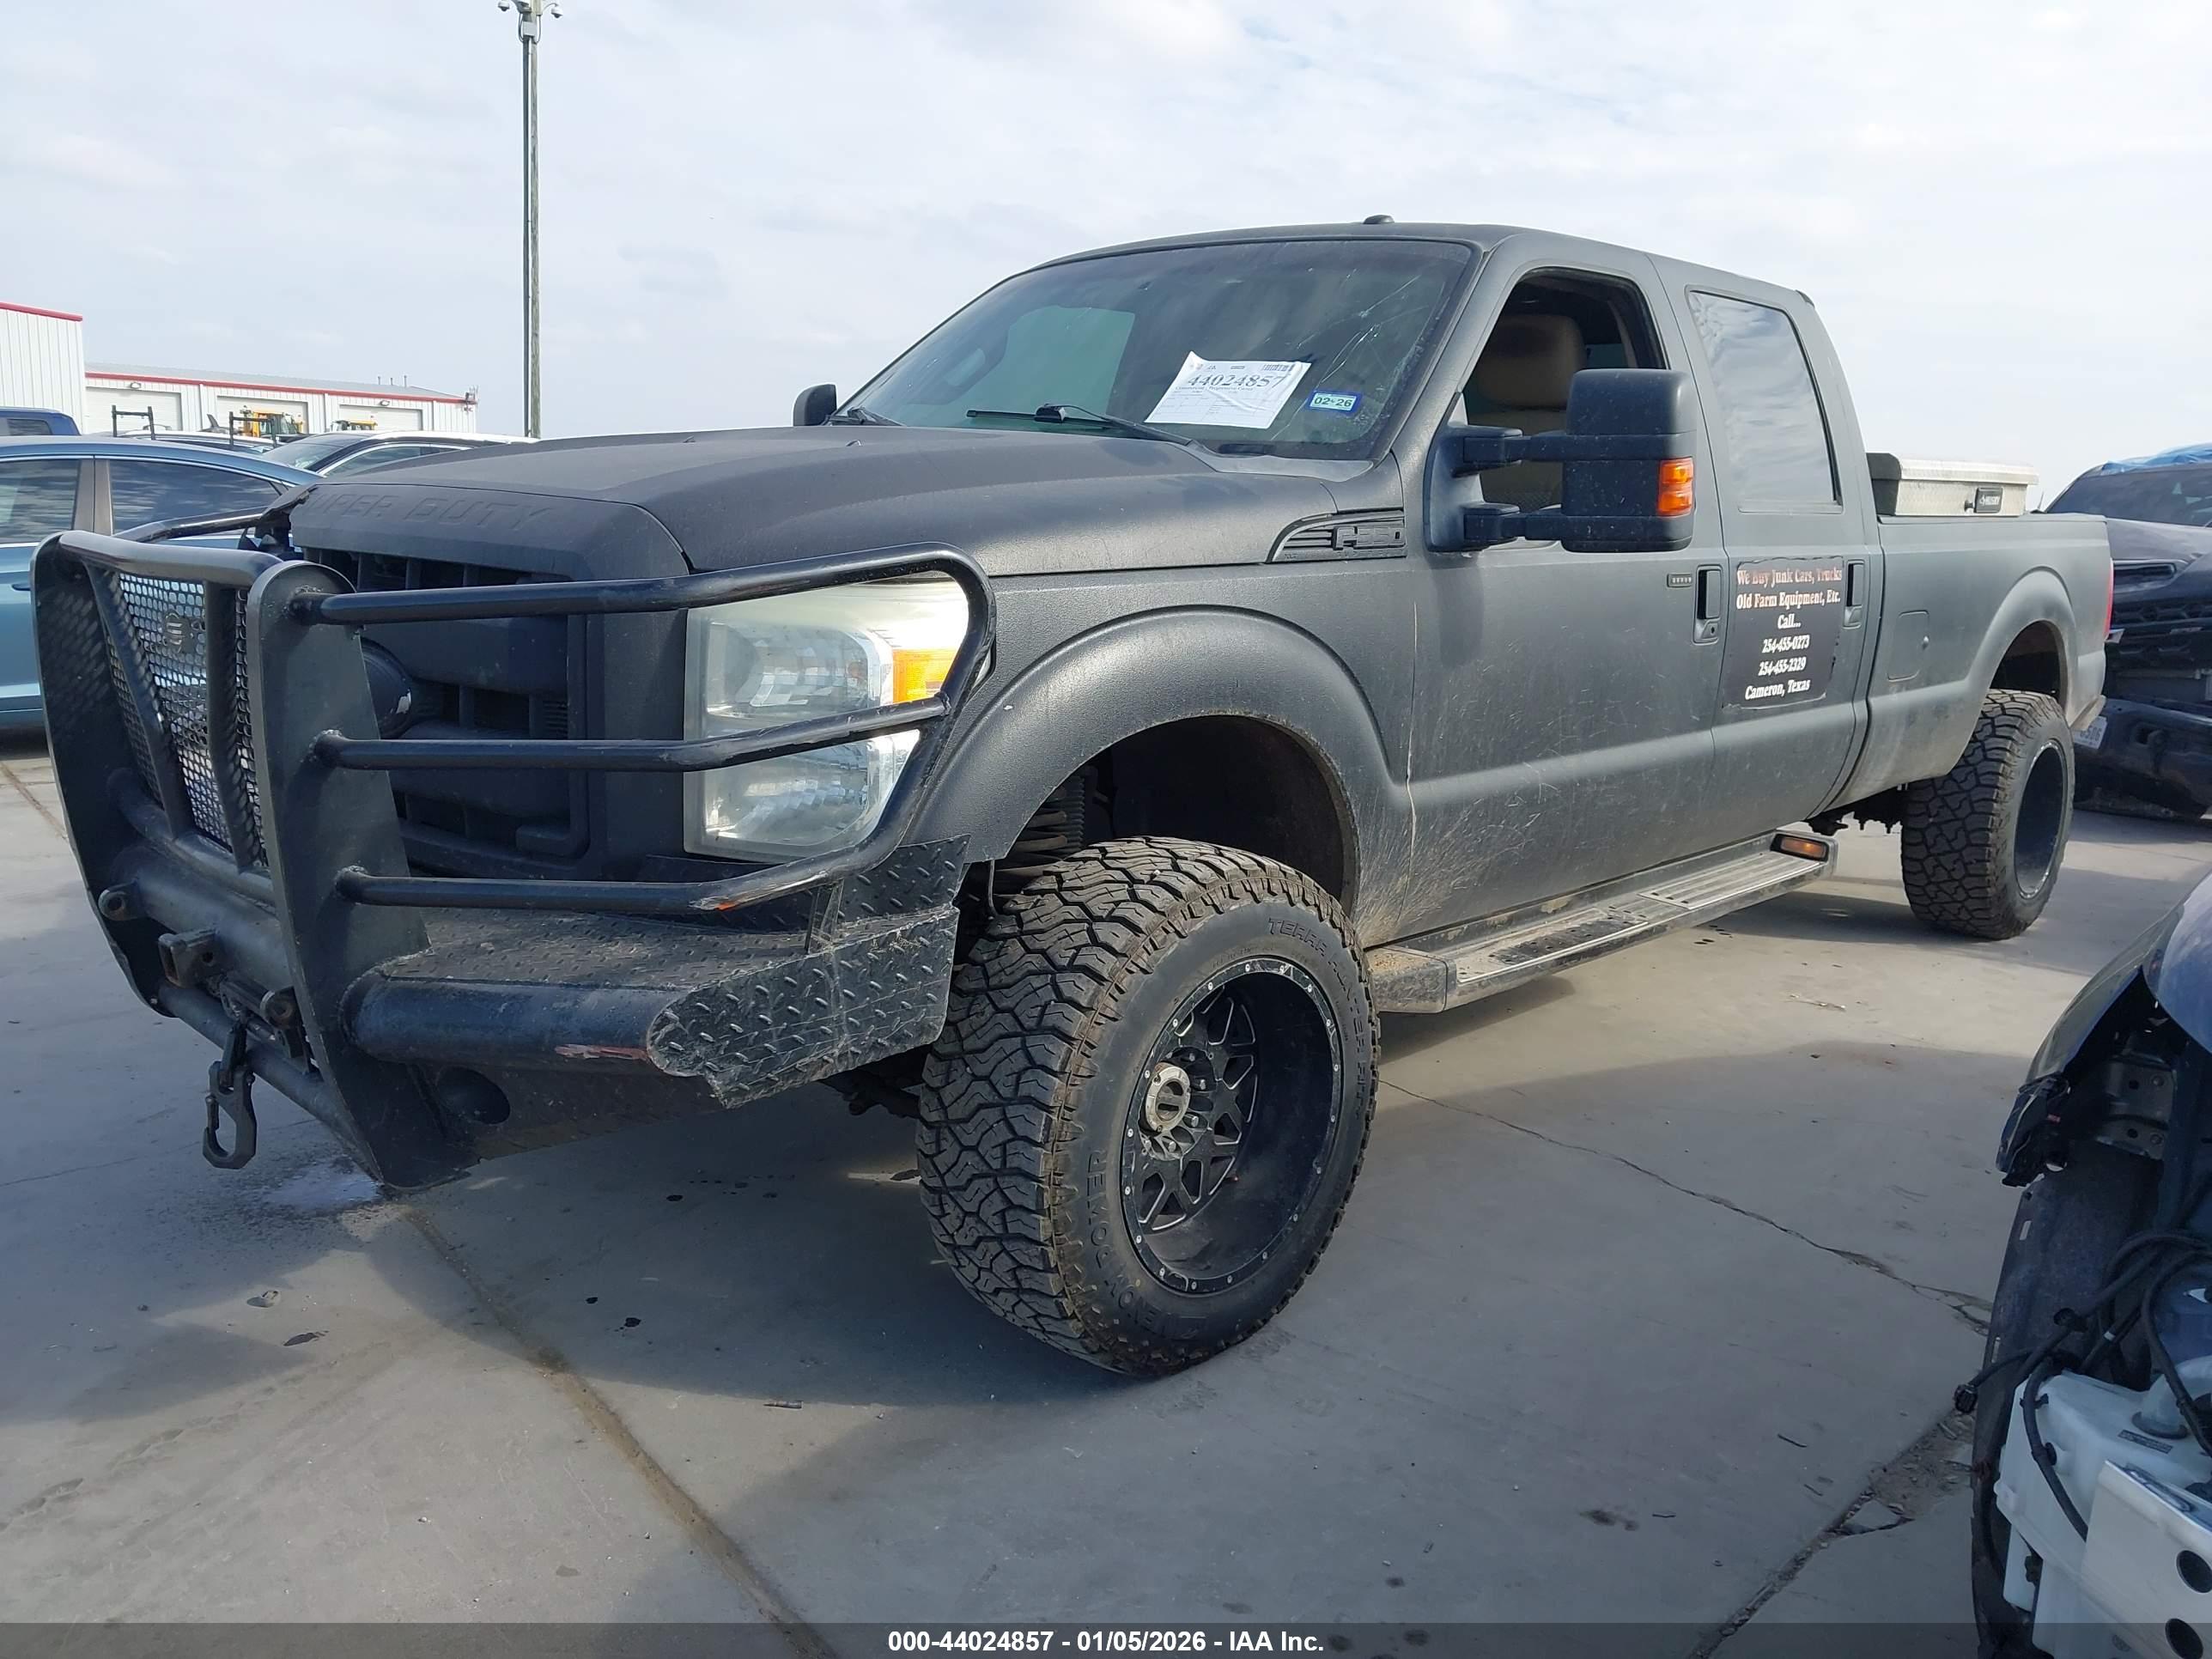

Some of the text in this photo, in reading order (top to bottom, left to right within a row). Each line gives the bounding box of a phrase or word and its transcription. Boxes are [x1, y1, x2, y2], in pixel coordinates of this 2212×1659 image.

[1188, 374, 1286, 388] 44024857
[1736, 569, 1751, 585] We
[1771, 568, 1793, 588] Junk
[1815, 567, 1843, 582] Trucks
[1735, 589, 1841, 611] Old Farm Equipment, Etc.
[1761, 634, 1811, 653] 254-455-0273
[1744, 679, 1811, 701] Cameron, Texas
[1267, 917, 1328, 957] TERRA
[1086, 1149, 1112, 1268] POWER
